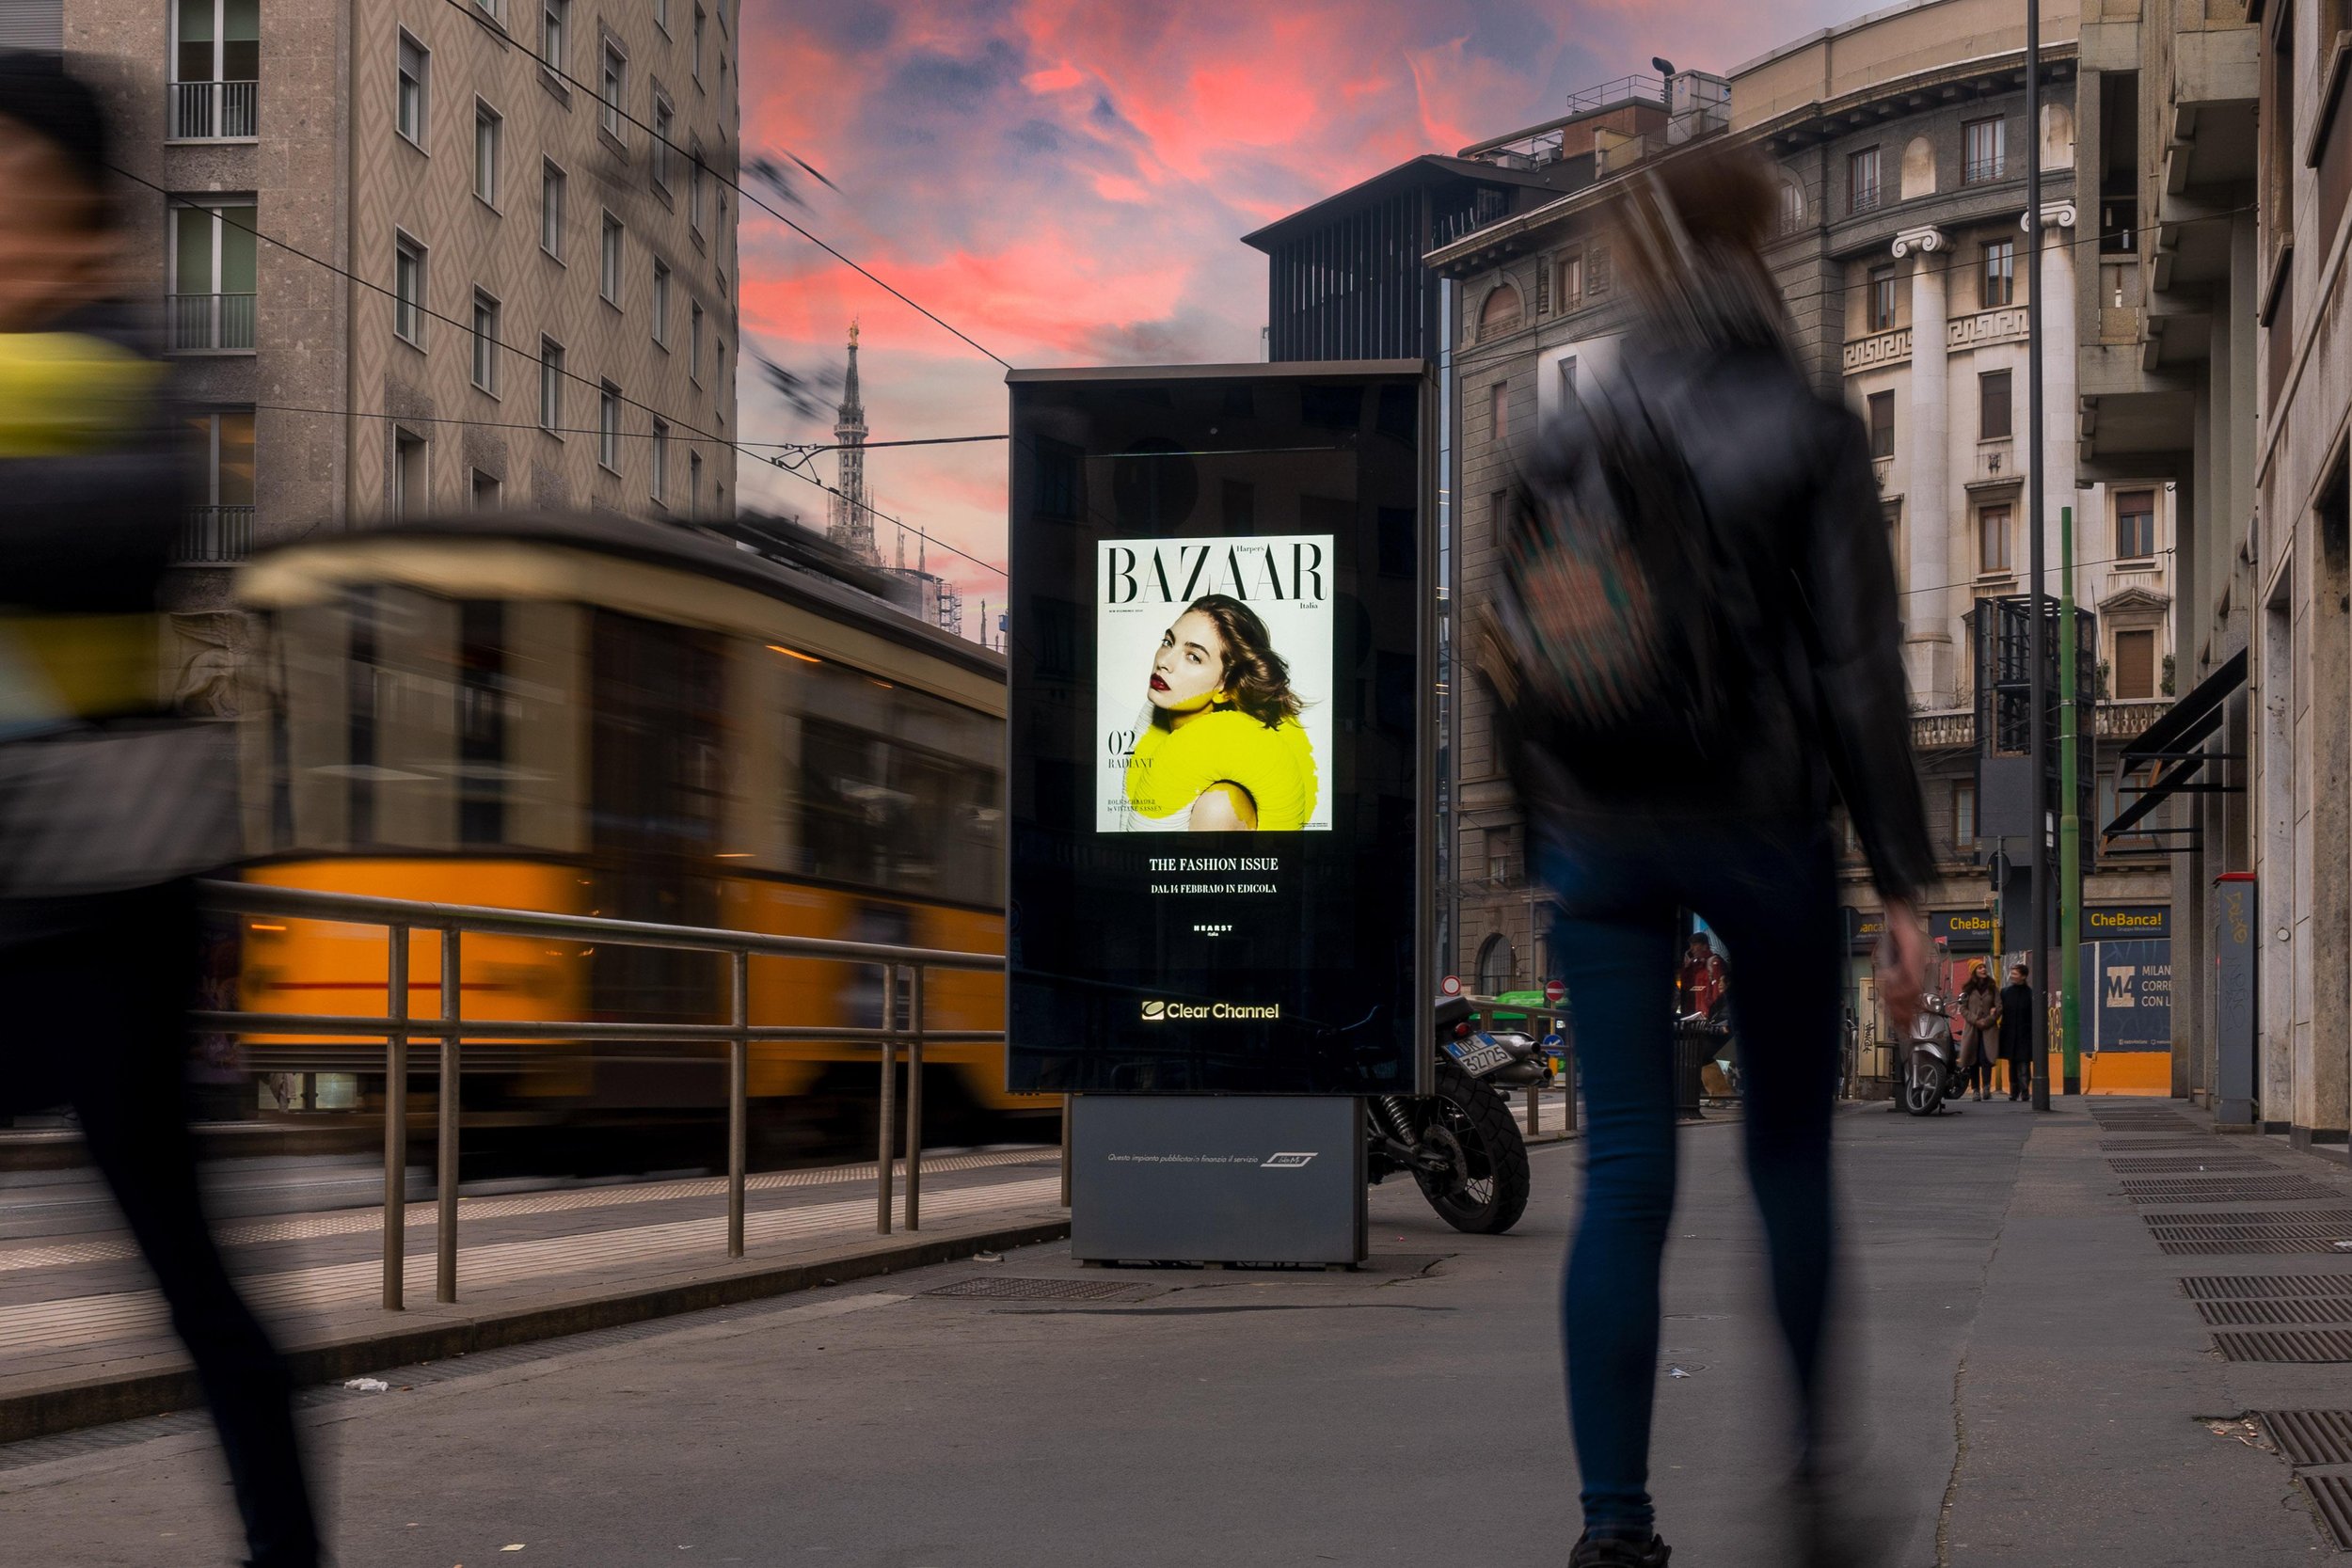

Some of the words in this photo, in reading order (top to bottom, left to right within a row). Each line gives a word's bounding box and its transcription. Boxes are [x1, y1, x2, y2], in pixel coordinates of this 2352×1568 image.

[1104, 543, 1327, 604] BAZAAR
[1108, 730, 1136, 755] 02
[1108, 758, 1154, 768] RADIANT
[1149, 858, 1176, 871] THE
[1180, 858, 1237, 871] FASHION
[1240, 858, 1279, 871] ISSUE
[1151, 884, 1169, 894] DAL
[1170, 884, 1179, 894] 14
[1181, 884, 1224, 894] FEBBRAIO
[1226, 884, 1235, 894] IN
[1237, 884, 1277, 894] EDICOLA
[2090, 911, 2162, 927] CheBanca!
[2142, 965, 2171, 975] MILAN
[2141, 996, 2163, 1006] CON
[1167, 1003, 1210, 1019] Clear
[1213, 1003, 1279, 1019] Channel
[1462, 1047, 1508, 1071] 32725
[1107, 1153, 1131, 1162] Questo
[1132, 1153, 1159, 1164] impianto
[1200, 1154, 1227, 1163] finanzia
[1228, 1154, 1232, 1163] il
[1233, 1155, 1259, 1164] servizio
